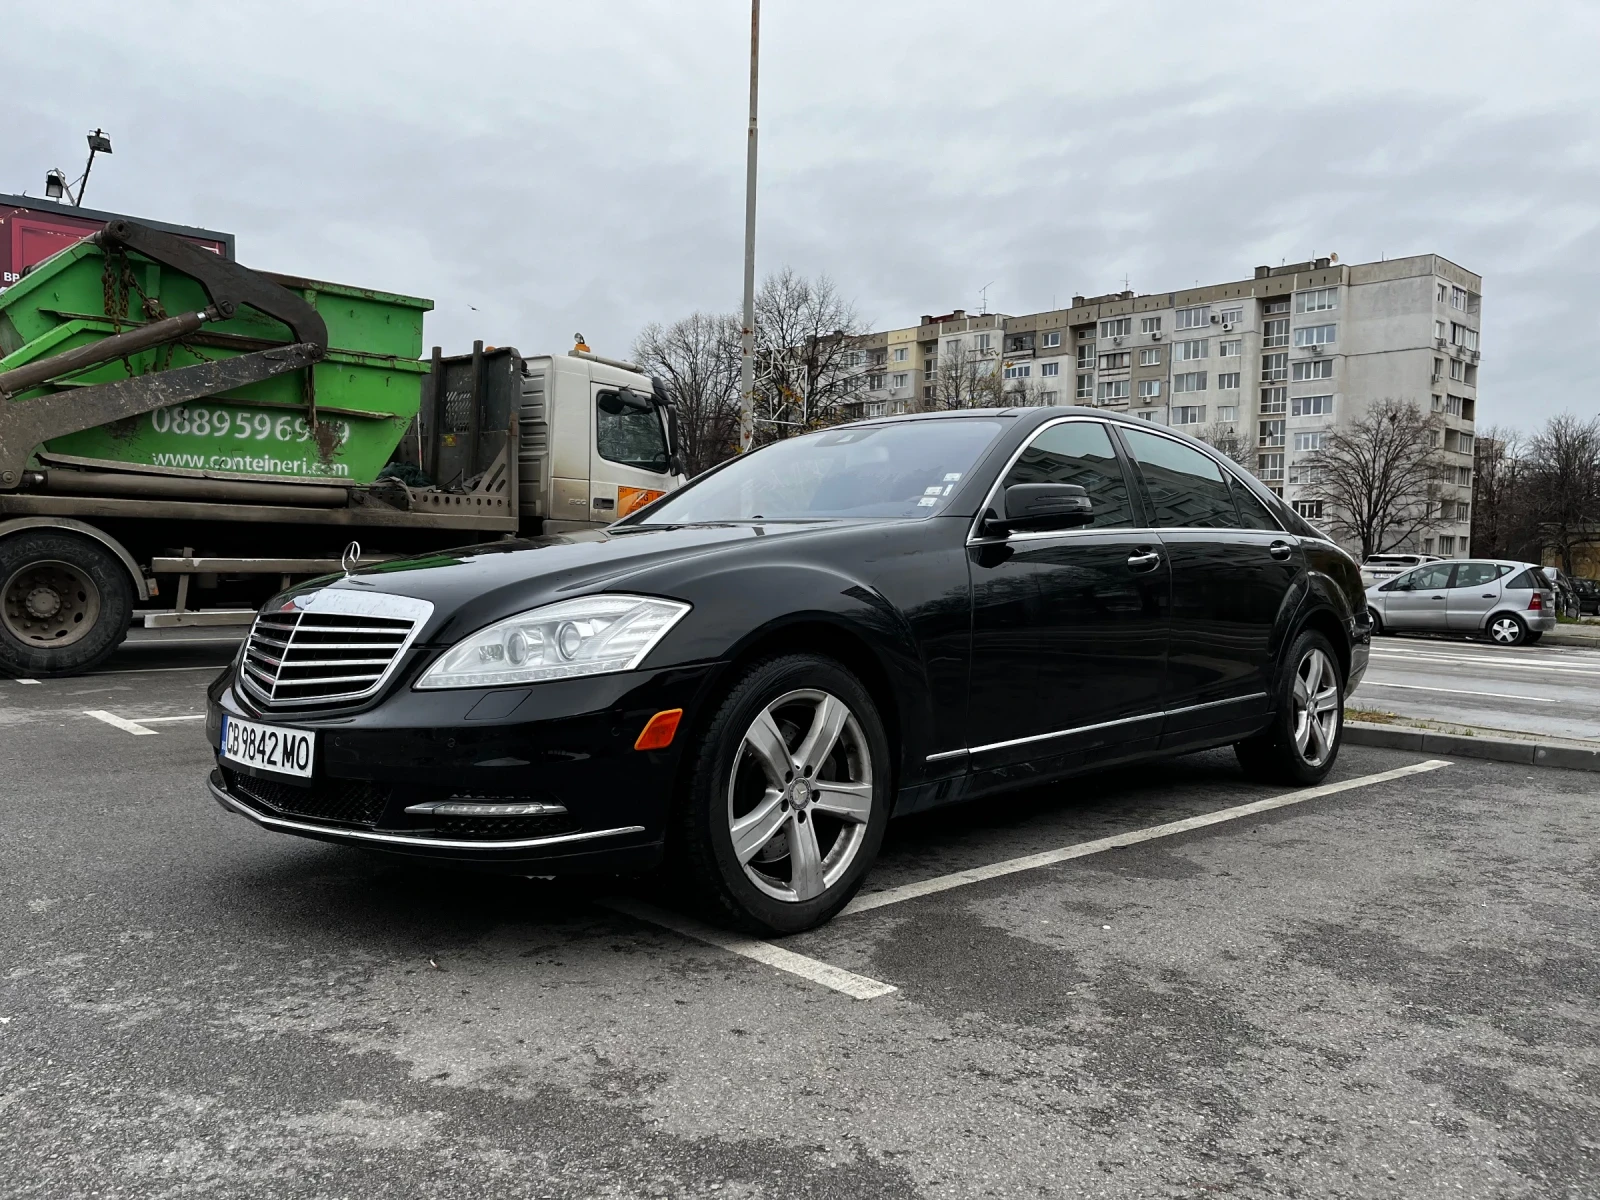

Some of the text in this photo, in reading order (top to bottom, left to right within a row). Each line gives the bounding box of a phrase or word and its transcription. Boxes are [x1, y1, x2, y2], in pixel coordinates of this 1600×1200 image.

[152, 407, 350, 443] 088959699
[227, 722, 309, 770] CB 9842 MO
